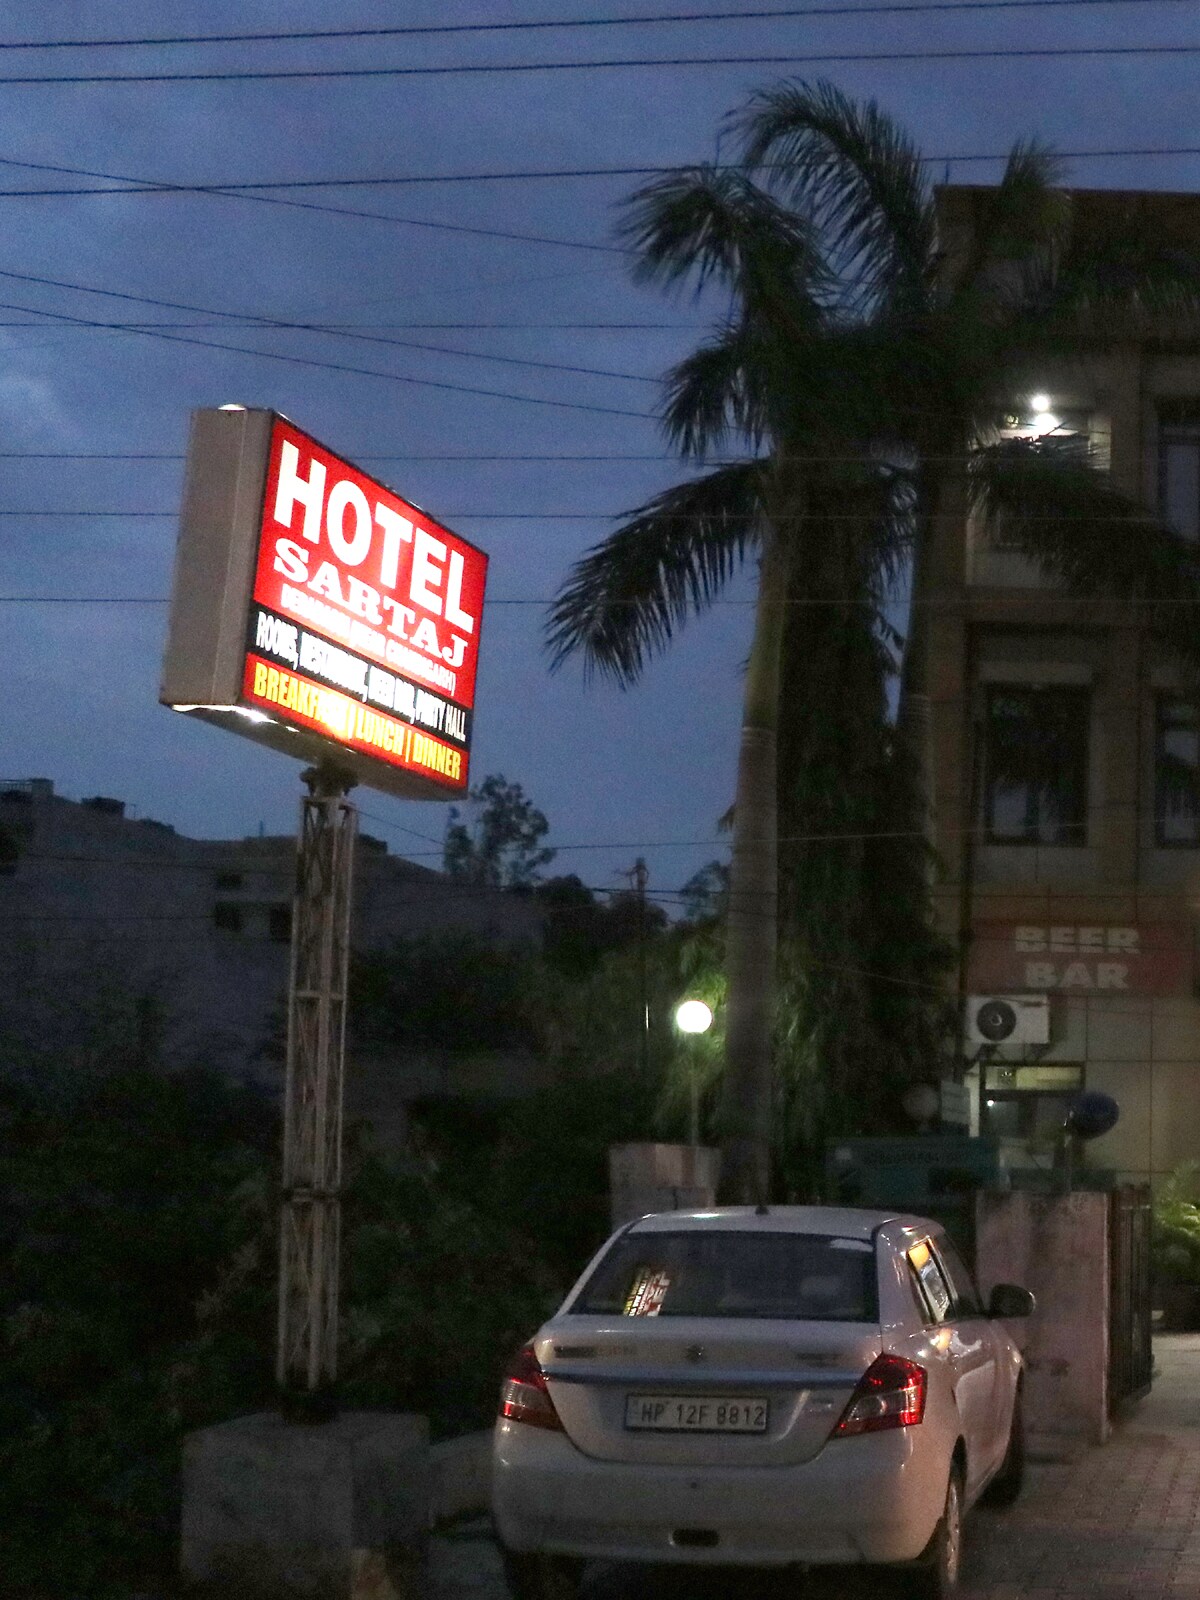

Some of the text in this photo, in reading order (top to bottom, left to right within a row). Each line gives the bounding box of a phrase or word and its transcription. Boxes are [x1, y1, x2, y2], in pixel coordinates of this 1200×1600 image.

[273, 439, 475, 635] HOTEL
[273, 537, 469, 668] SARTAJ
[355, 707, 404, 756] LUNCH
[412, 732, 461, 780] DINNER
[1015, 925, 1141, 954] BEER
[1024, 962, 1130, 989] BAR
[642, 1403, 665, 1422] HP
[717, 1405, 765, 1426] 8812
